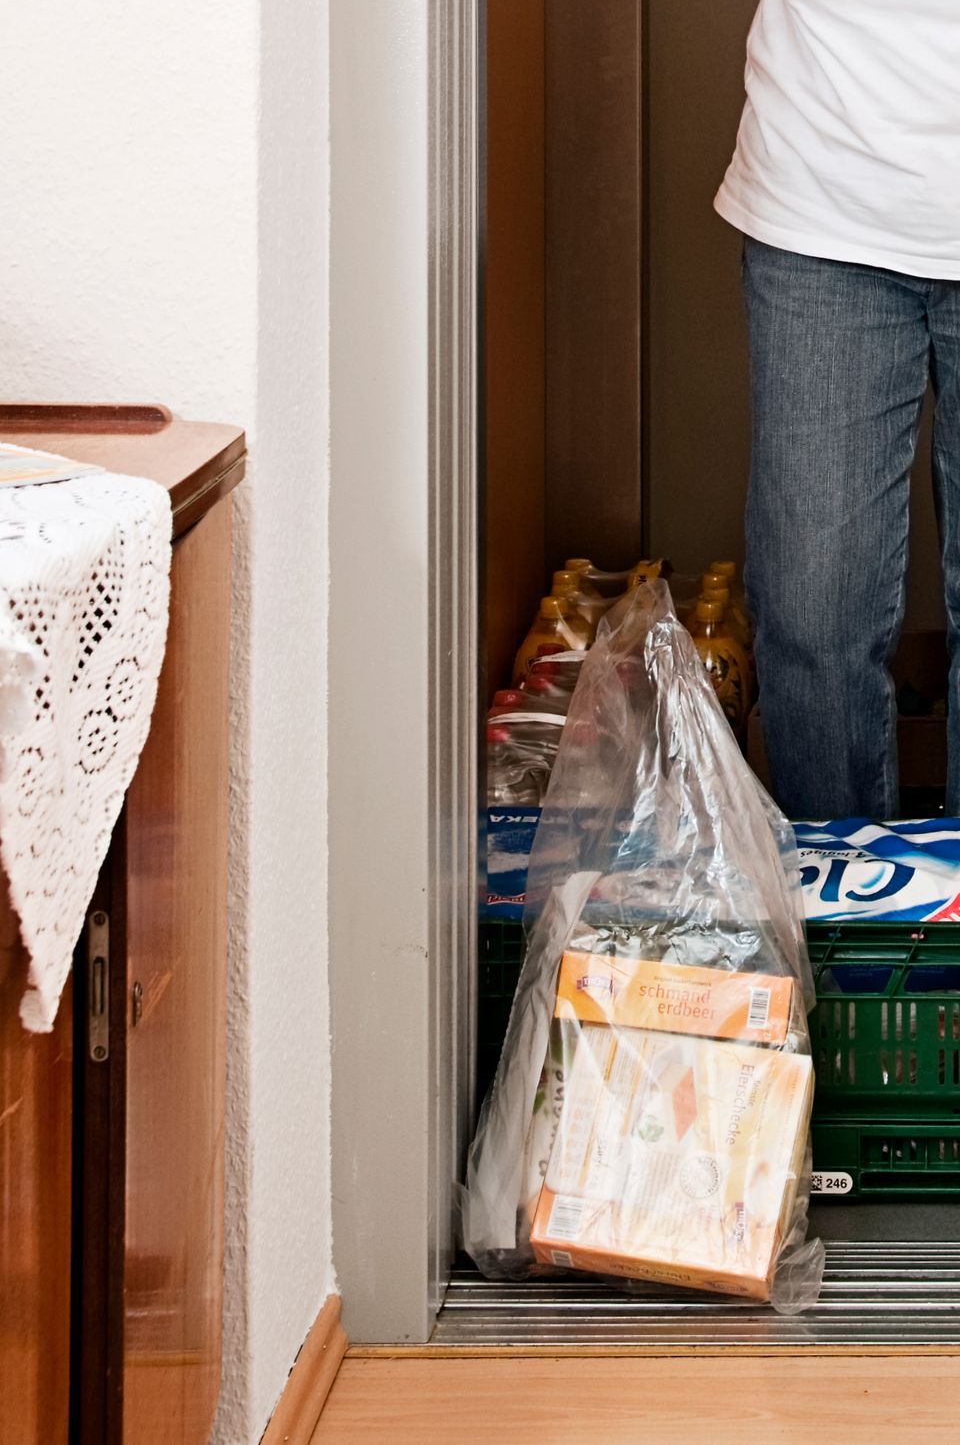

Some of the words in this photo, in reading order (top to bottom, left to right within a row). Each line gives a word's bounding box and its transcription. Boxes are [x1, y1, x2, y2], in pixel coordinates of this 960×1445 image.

[639, 983, 711, 1004] schmand
[658, 1002, 717, 1020] erdbeer
[725, 1064, 755, 1146] Eierschecke
[826, 1178, 848, 1188] 246
